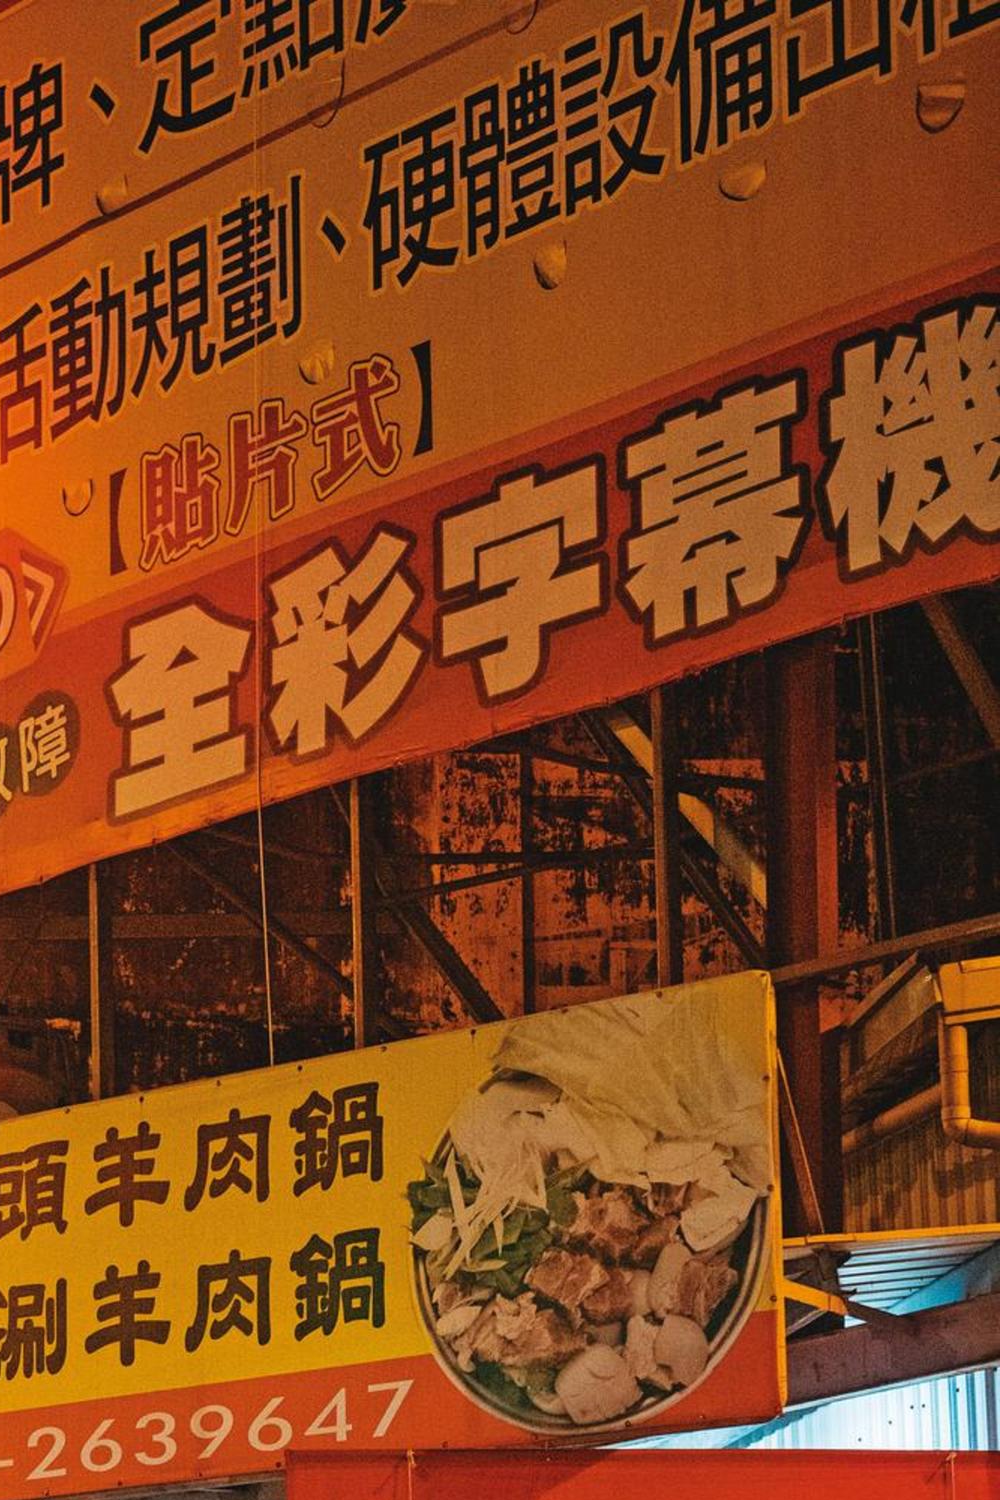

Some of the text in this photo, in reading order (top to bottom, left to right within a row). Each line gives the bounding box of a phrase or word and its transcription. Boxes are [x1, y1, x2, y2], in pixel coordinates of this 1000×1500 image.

[104, 296, 1000, 826] 全彩字幕機
